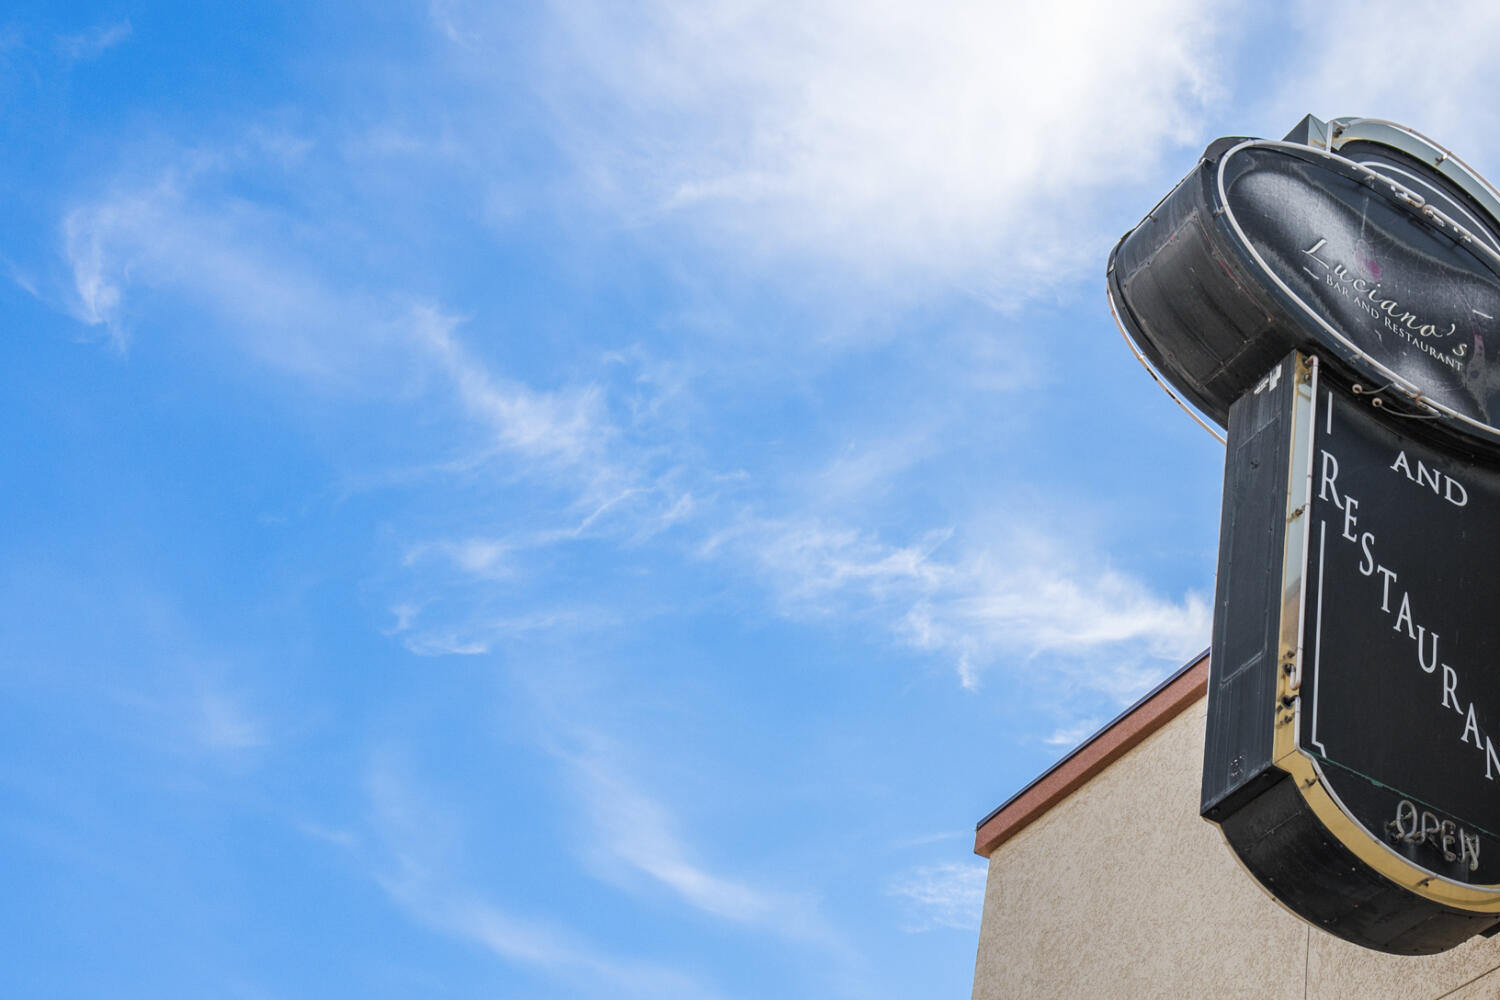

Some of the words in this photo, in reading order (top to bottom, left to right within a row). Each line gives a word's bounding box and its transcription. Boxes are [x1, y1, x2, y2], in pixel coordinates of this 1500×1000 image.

[1302, 238, 1468, 357] Luciano's
[1326, 274, 1348, 297] BAR
[1353, 296, 1380, 320] AND
[1384, 316, 1464, 372] RESTAURANT
[1390, 450, 1468, 507] AND
[1397, 799, 1480, 871] OPEN
